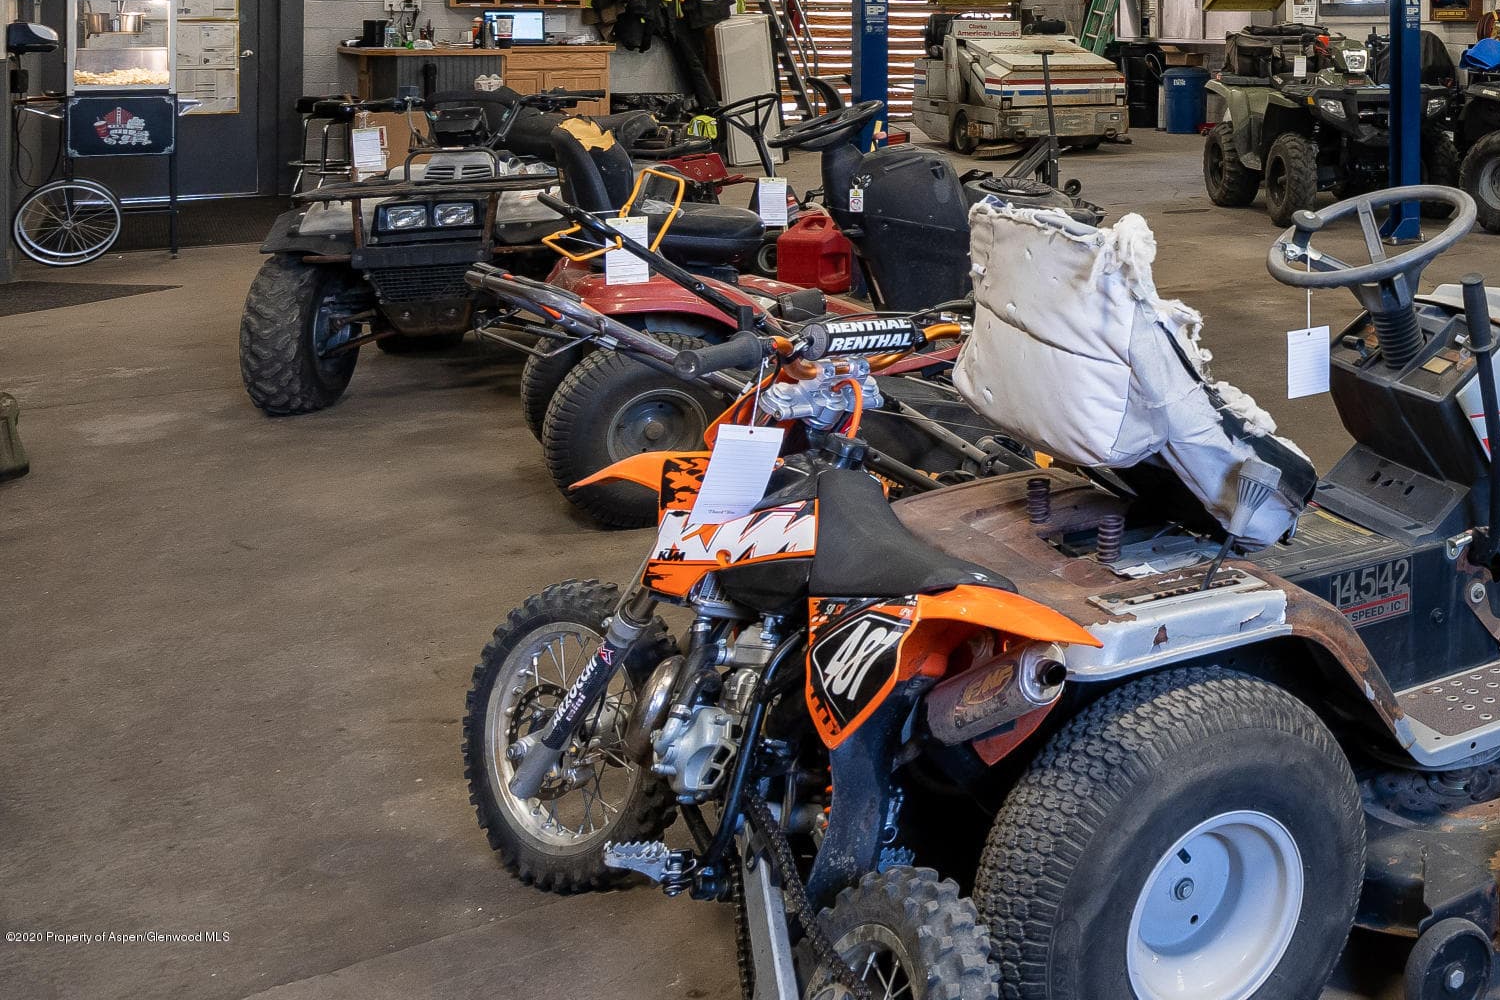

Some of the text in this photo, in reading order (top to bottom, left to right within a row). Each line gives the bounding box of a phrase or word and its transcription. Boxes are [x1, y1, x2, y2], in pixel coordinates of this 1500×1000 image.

[826, 318, 912, 334] RENTHAL
[828, 332, 913, 352] RENTHAL
[656, 549, 687, 562] KTM
[1351, 605, 1385, 622] SPEED
[823, 619, 904, 702] 487
